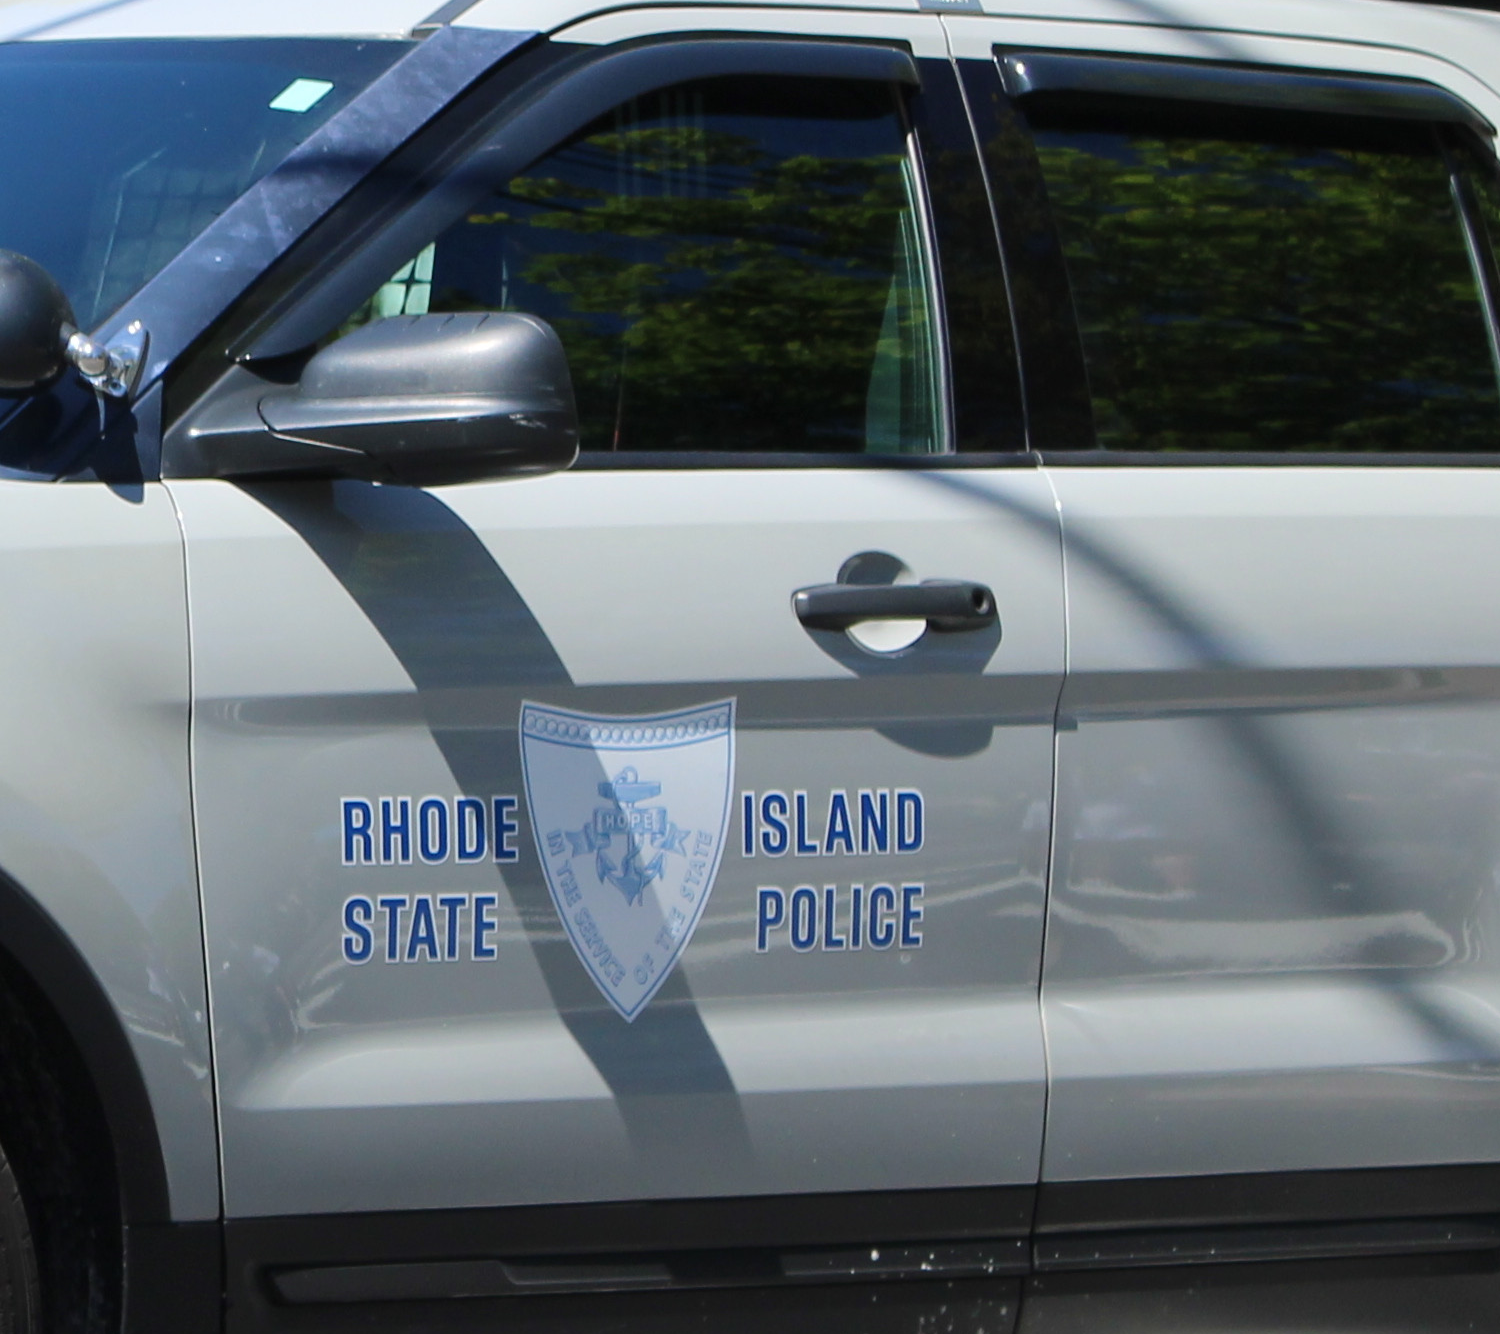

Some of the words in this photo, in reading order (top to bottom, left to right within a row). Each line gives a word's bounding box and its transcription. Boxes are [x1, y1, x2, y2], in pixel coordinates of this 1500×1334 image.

[340, 795, 519, 866] RHODE
[742, 788, 925, 857] ISLAND
[605, 812, 652, 830] HOPE
[342, 892, 498, 965] STATE
[756, 882, 924, 953] POLICE
[547, 829, 565, 857] IN
[556, 860, 583, 908] THE
[574, 909, 626, 987] SERVICE
[633, 953, 657, 986] OF
[655, 908, 687, 951] THE
[679, 828, 714, 905] STATE
